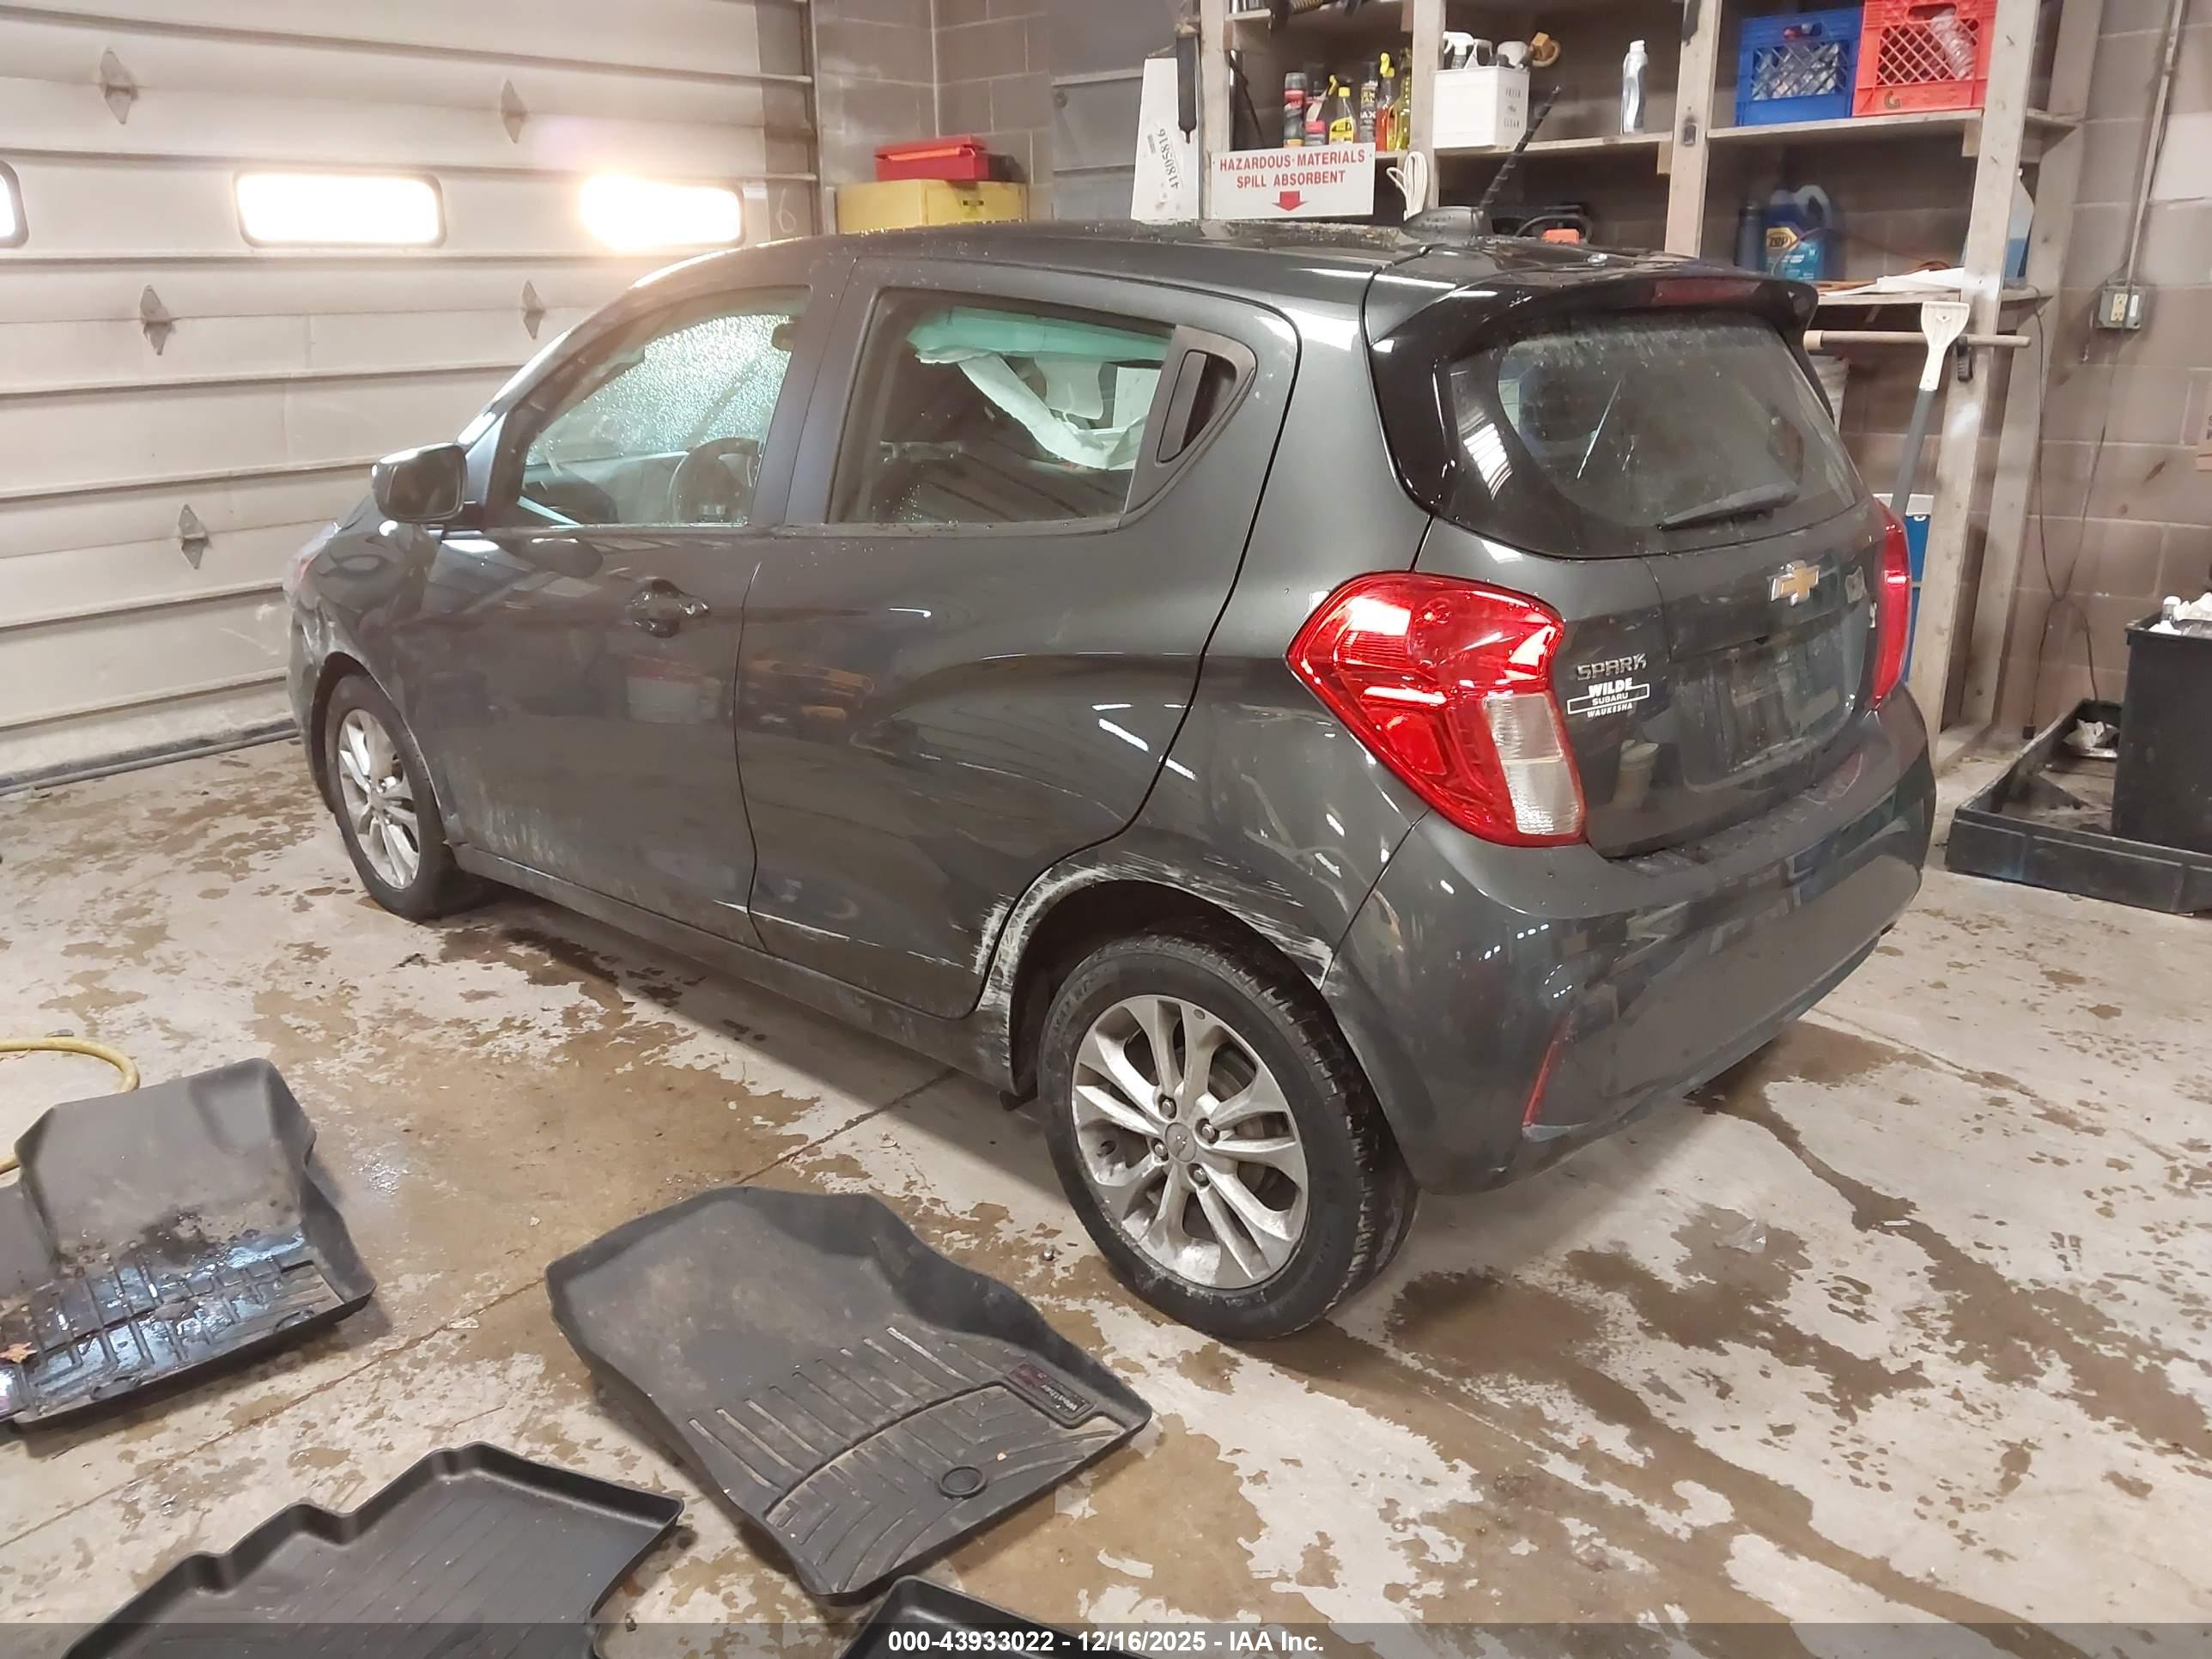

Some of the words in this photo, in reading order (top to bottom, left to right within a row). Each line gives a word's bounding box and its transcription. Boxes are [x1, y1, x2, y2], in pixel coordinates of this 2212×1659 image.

[1158, 128, 1181, 190] 41805816
[1219, 155, 1291, 171] HAZARDOUS
[1297, 149, 1365, 167] MATERIALS
[1237, 175, 1267, 189] SPILL
[1273, 170, 1346, 186] ABSORBENT
[1577, 653, 1647, 681] SPARK
[1588, 677, 1633, 698] WILDE
[1591, 692, 1629, 706] SUBARU
[1587, 702, 1633, 719] WAUKESHA
